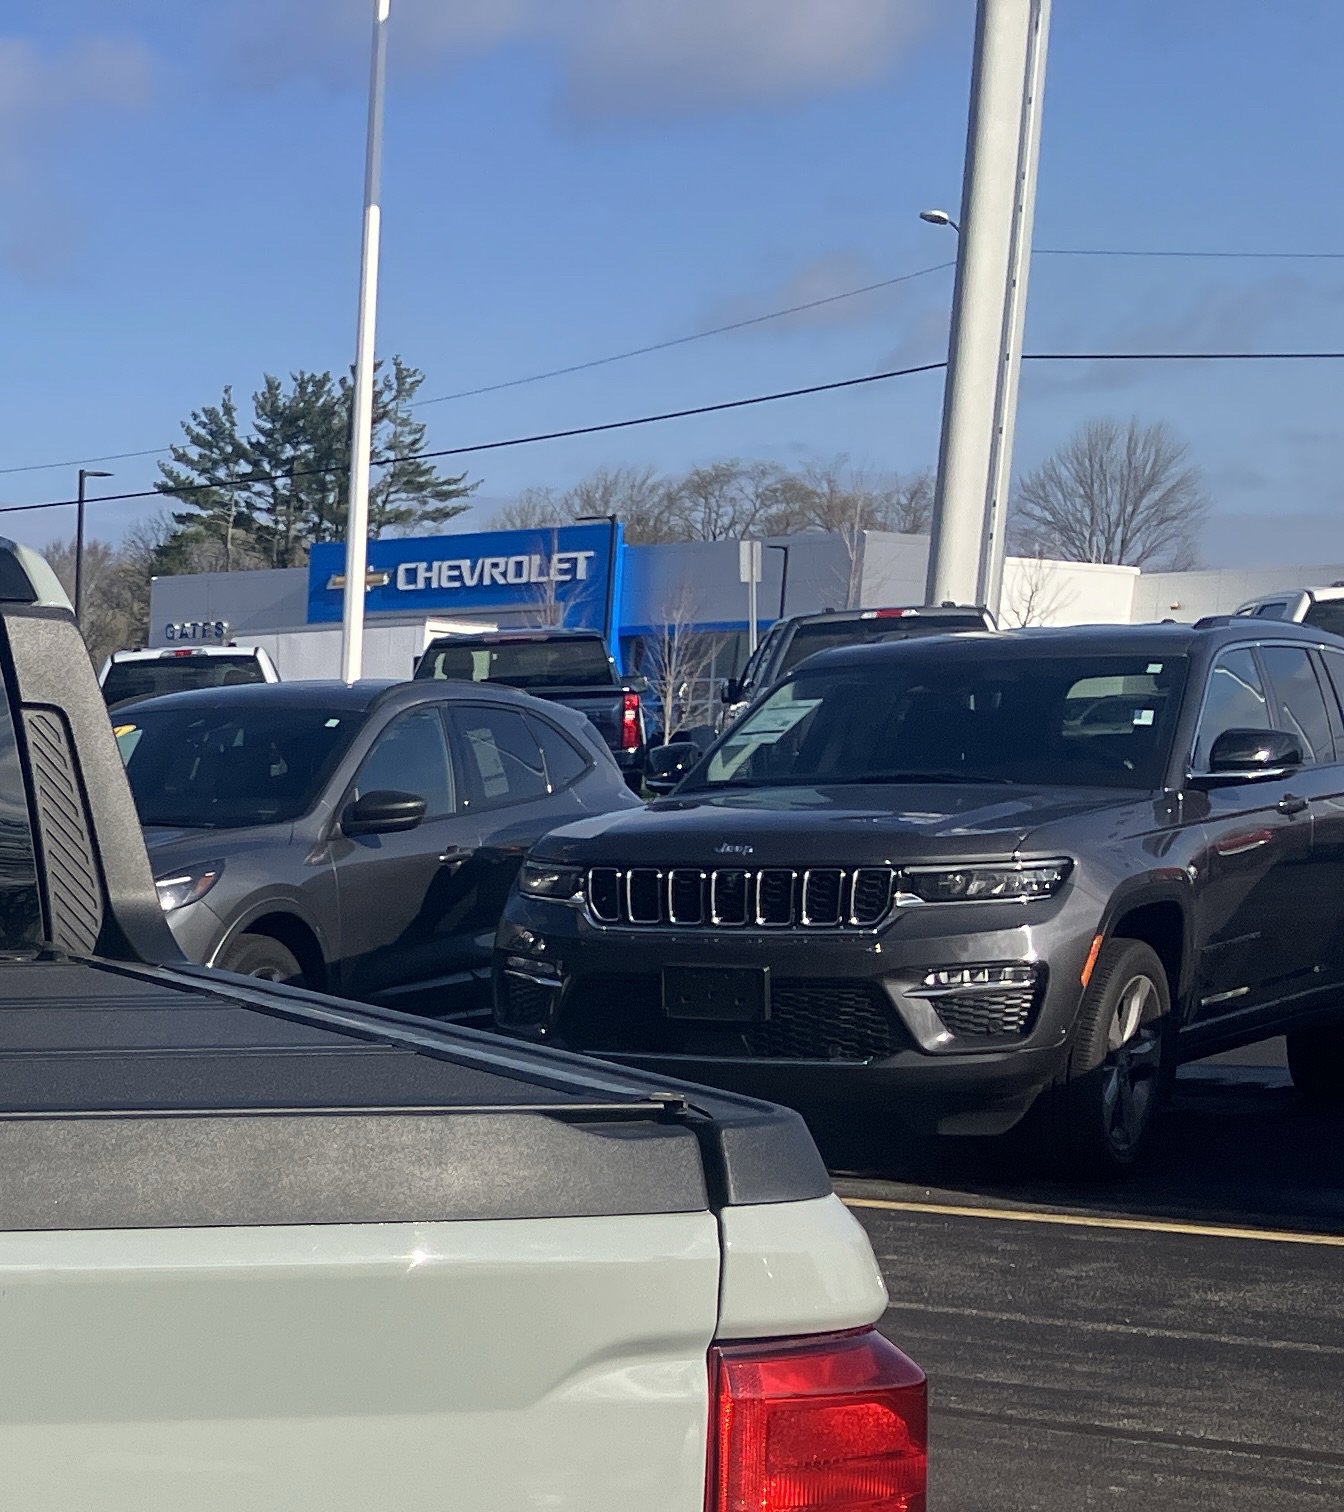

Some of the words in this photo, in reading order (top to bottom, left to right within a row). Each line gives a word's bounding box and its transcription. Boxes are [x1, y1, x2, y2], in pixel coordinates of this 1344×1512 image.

[396, 551, 595, 591] CHEVROLET
[165, 621, 225, 640] GATES
[715, 841, 753, 856] Jeep
